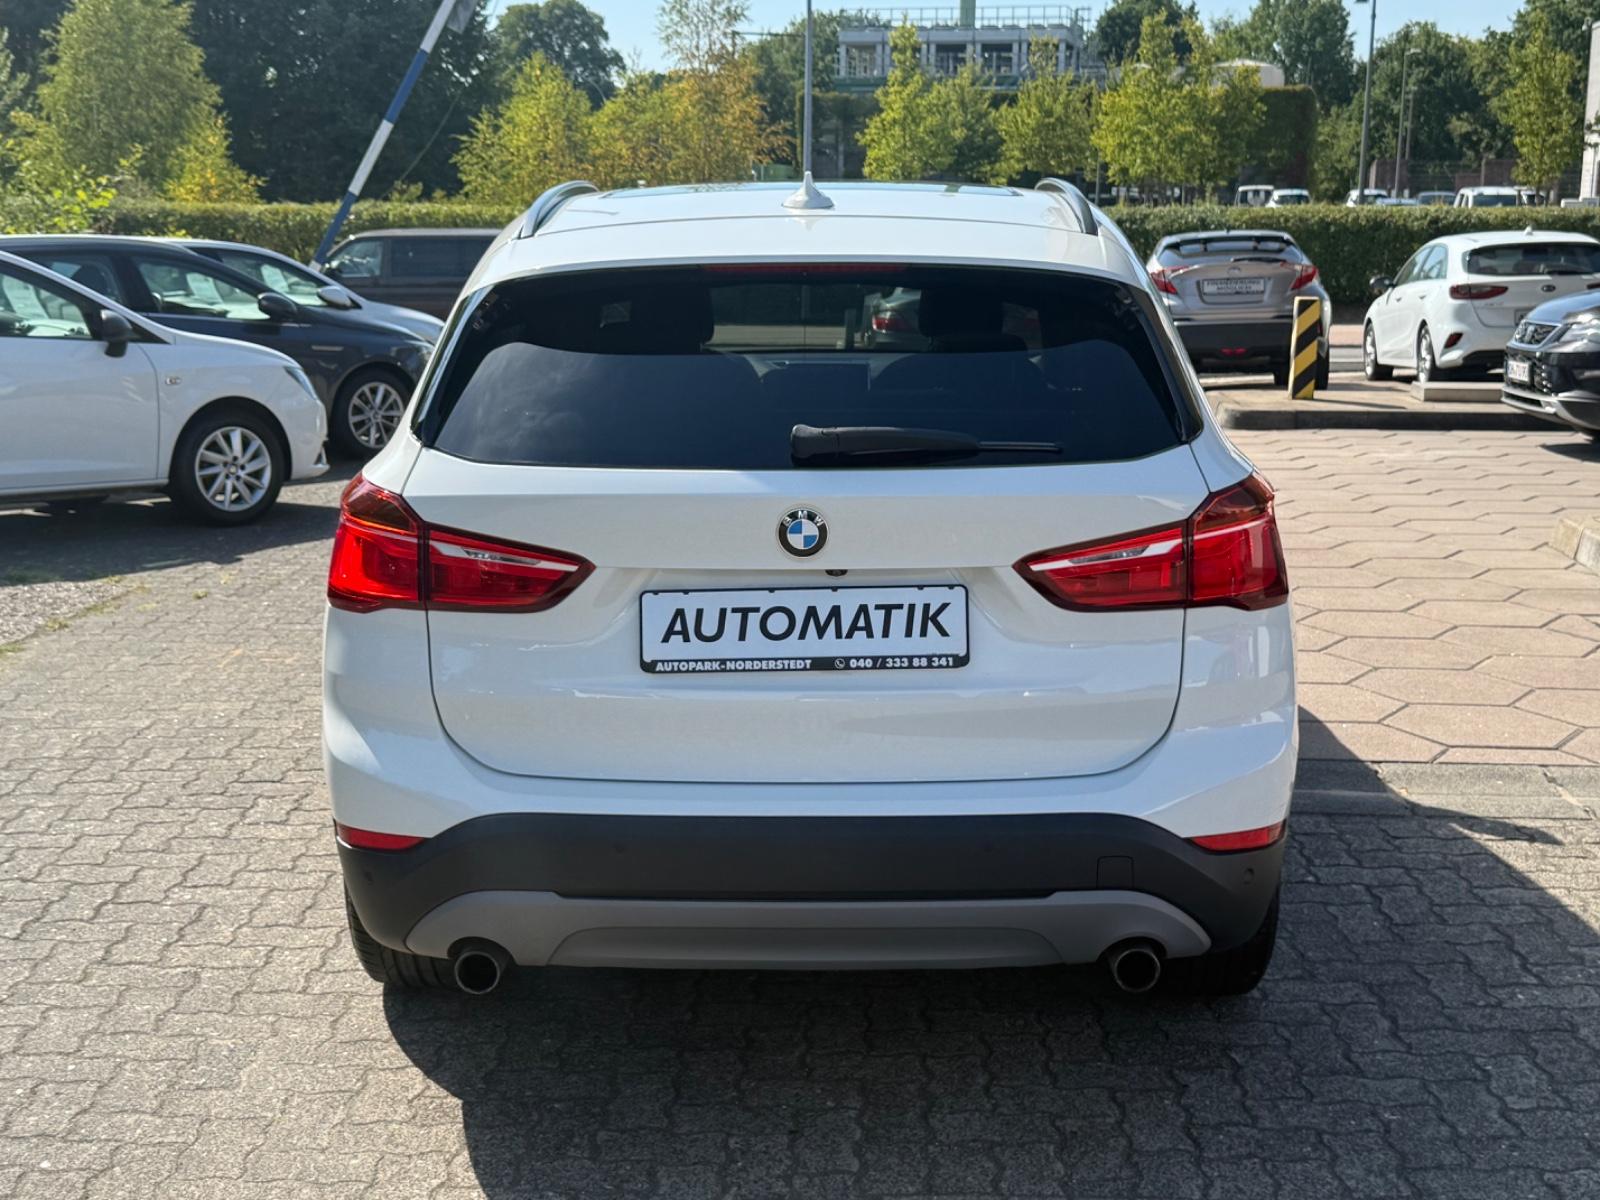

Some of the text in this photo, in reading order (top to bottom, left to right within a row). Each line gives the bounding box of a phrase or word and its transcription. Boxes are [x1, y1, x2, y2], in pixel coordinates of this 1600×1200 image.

[660, 602, 951, 643] AUTOMATIK
[655, 659, 812, 672] AUTOPARK-NORDERSTEDT
[849, 658, 873, 668] 040
[885, 657, 909, 667] 333
[912, 657, 928, 667] 88
[931, 656, 953, 667] 341
